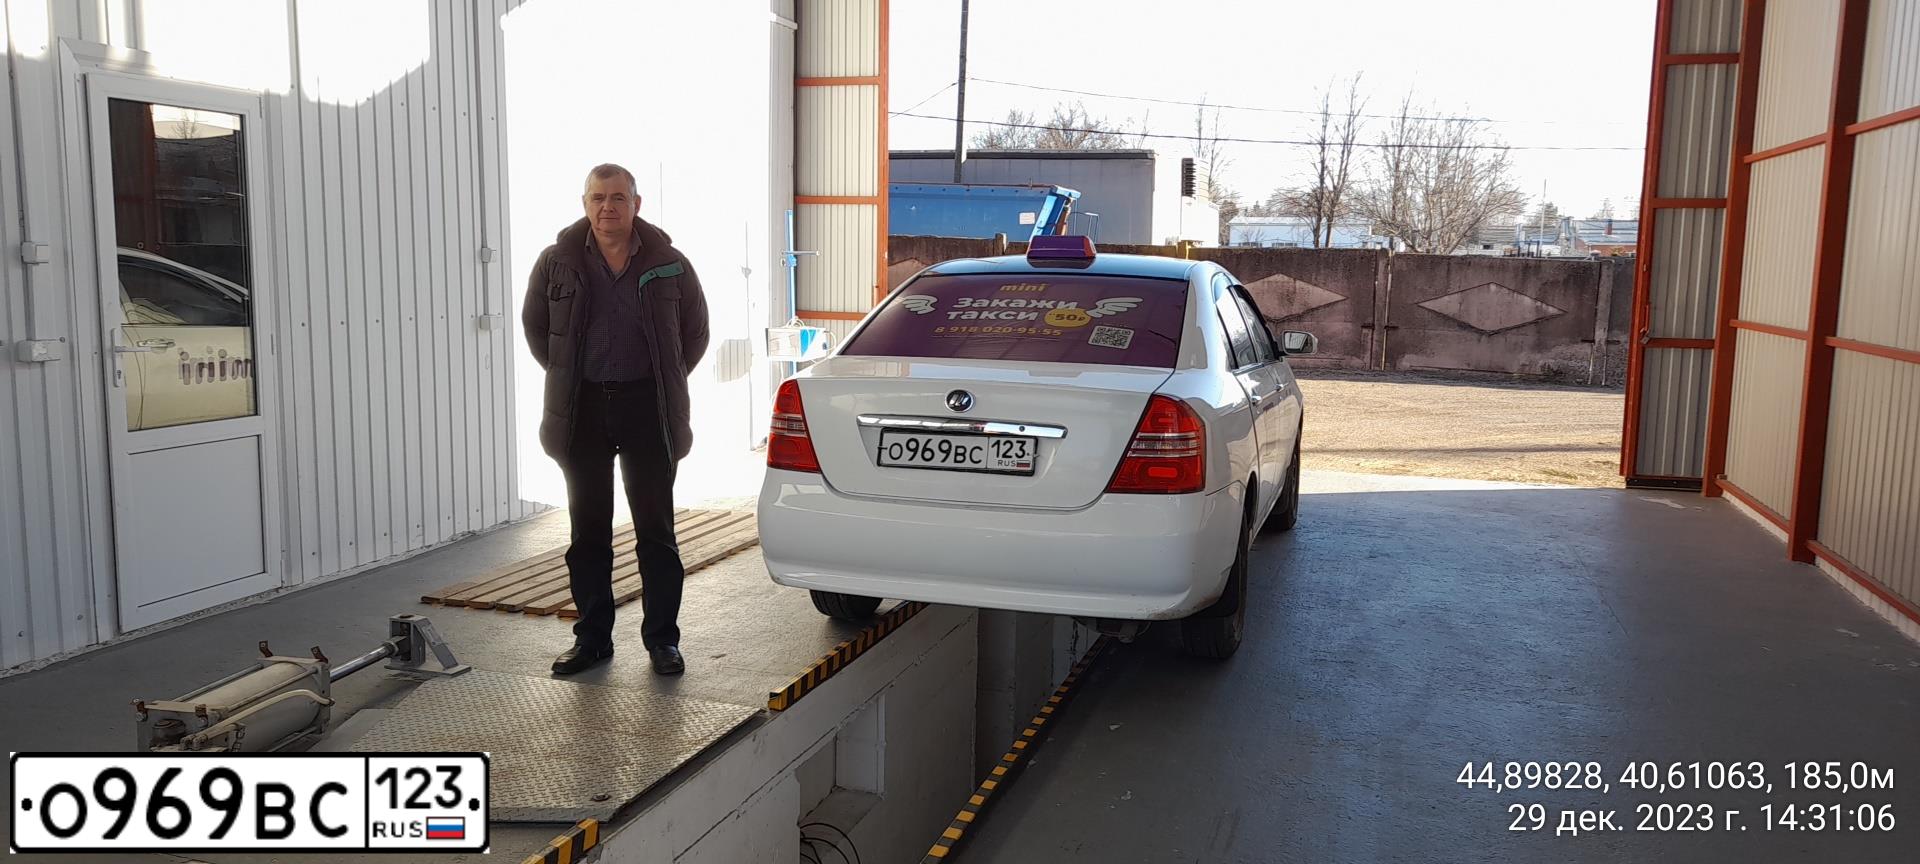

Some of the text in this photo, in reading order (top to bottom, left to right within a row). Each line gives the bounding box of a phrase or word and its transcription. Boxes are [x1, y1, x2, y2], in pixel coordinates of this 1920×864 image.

[1000, 283, 1047, 292] mini
[953, 298, 1078, 310] Закажи
[946, 310, 1039, 321] такси
[991, 439, 1027, 459] 123
[997, 459, 1016, 467] RUS
